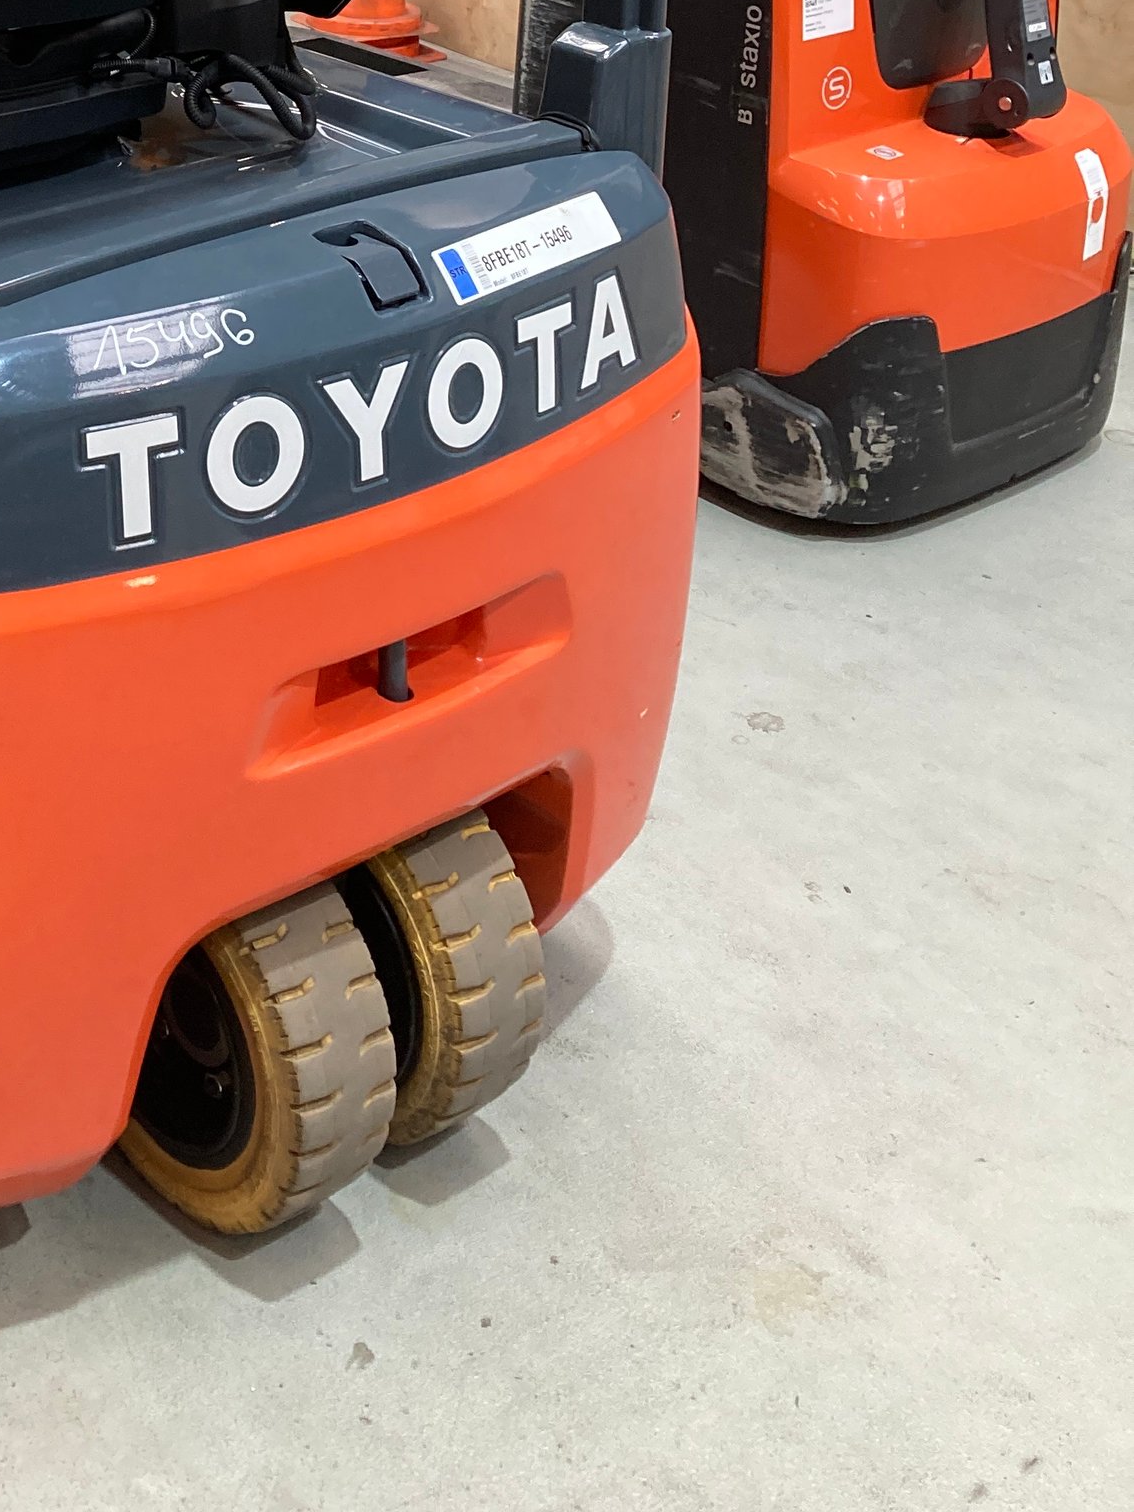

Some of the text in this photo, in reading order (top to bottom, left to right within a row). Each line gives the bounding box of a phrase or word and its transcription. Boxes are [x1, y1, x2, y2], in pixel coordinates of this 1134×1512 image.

[739, 5, 763, 89] staxio
[449, 266, 467, 279] STR
[482, 240, 533, 272] 8FBE18T
[540, 225, 573, 249] 15496
[93, 308, 255, 376] 15496
[84, 274, 638, 539] TOYOTA
